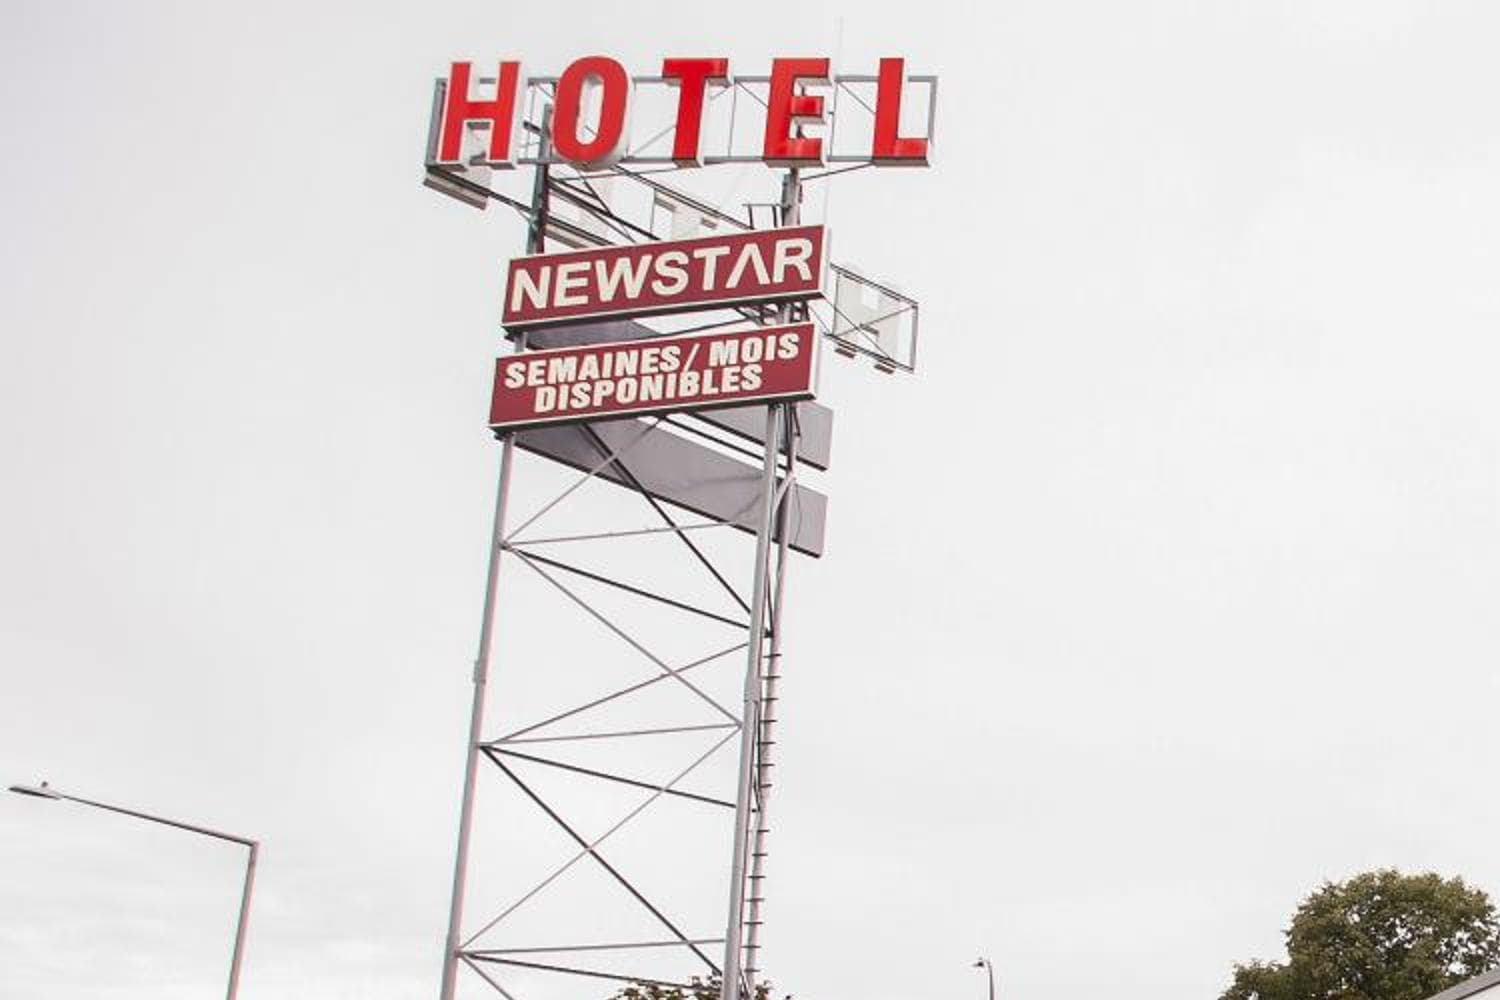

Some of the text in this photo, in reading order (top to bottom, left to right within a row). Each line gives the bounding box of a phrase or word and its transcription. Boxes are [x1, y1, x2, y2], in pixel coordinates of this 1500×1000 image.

[436, 55, 931, 168] HOTEL
[511, 237, 814, 313] NEWSTAR
[708, 332, 800, 367] MOIS
[534, 364, 763, 413] DISPONIBLES
